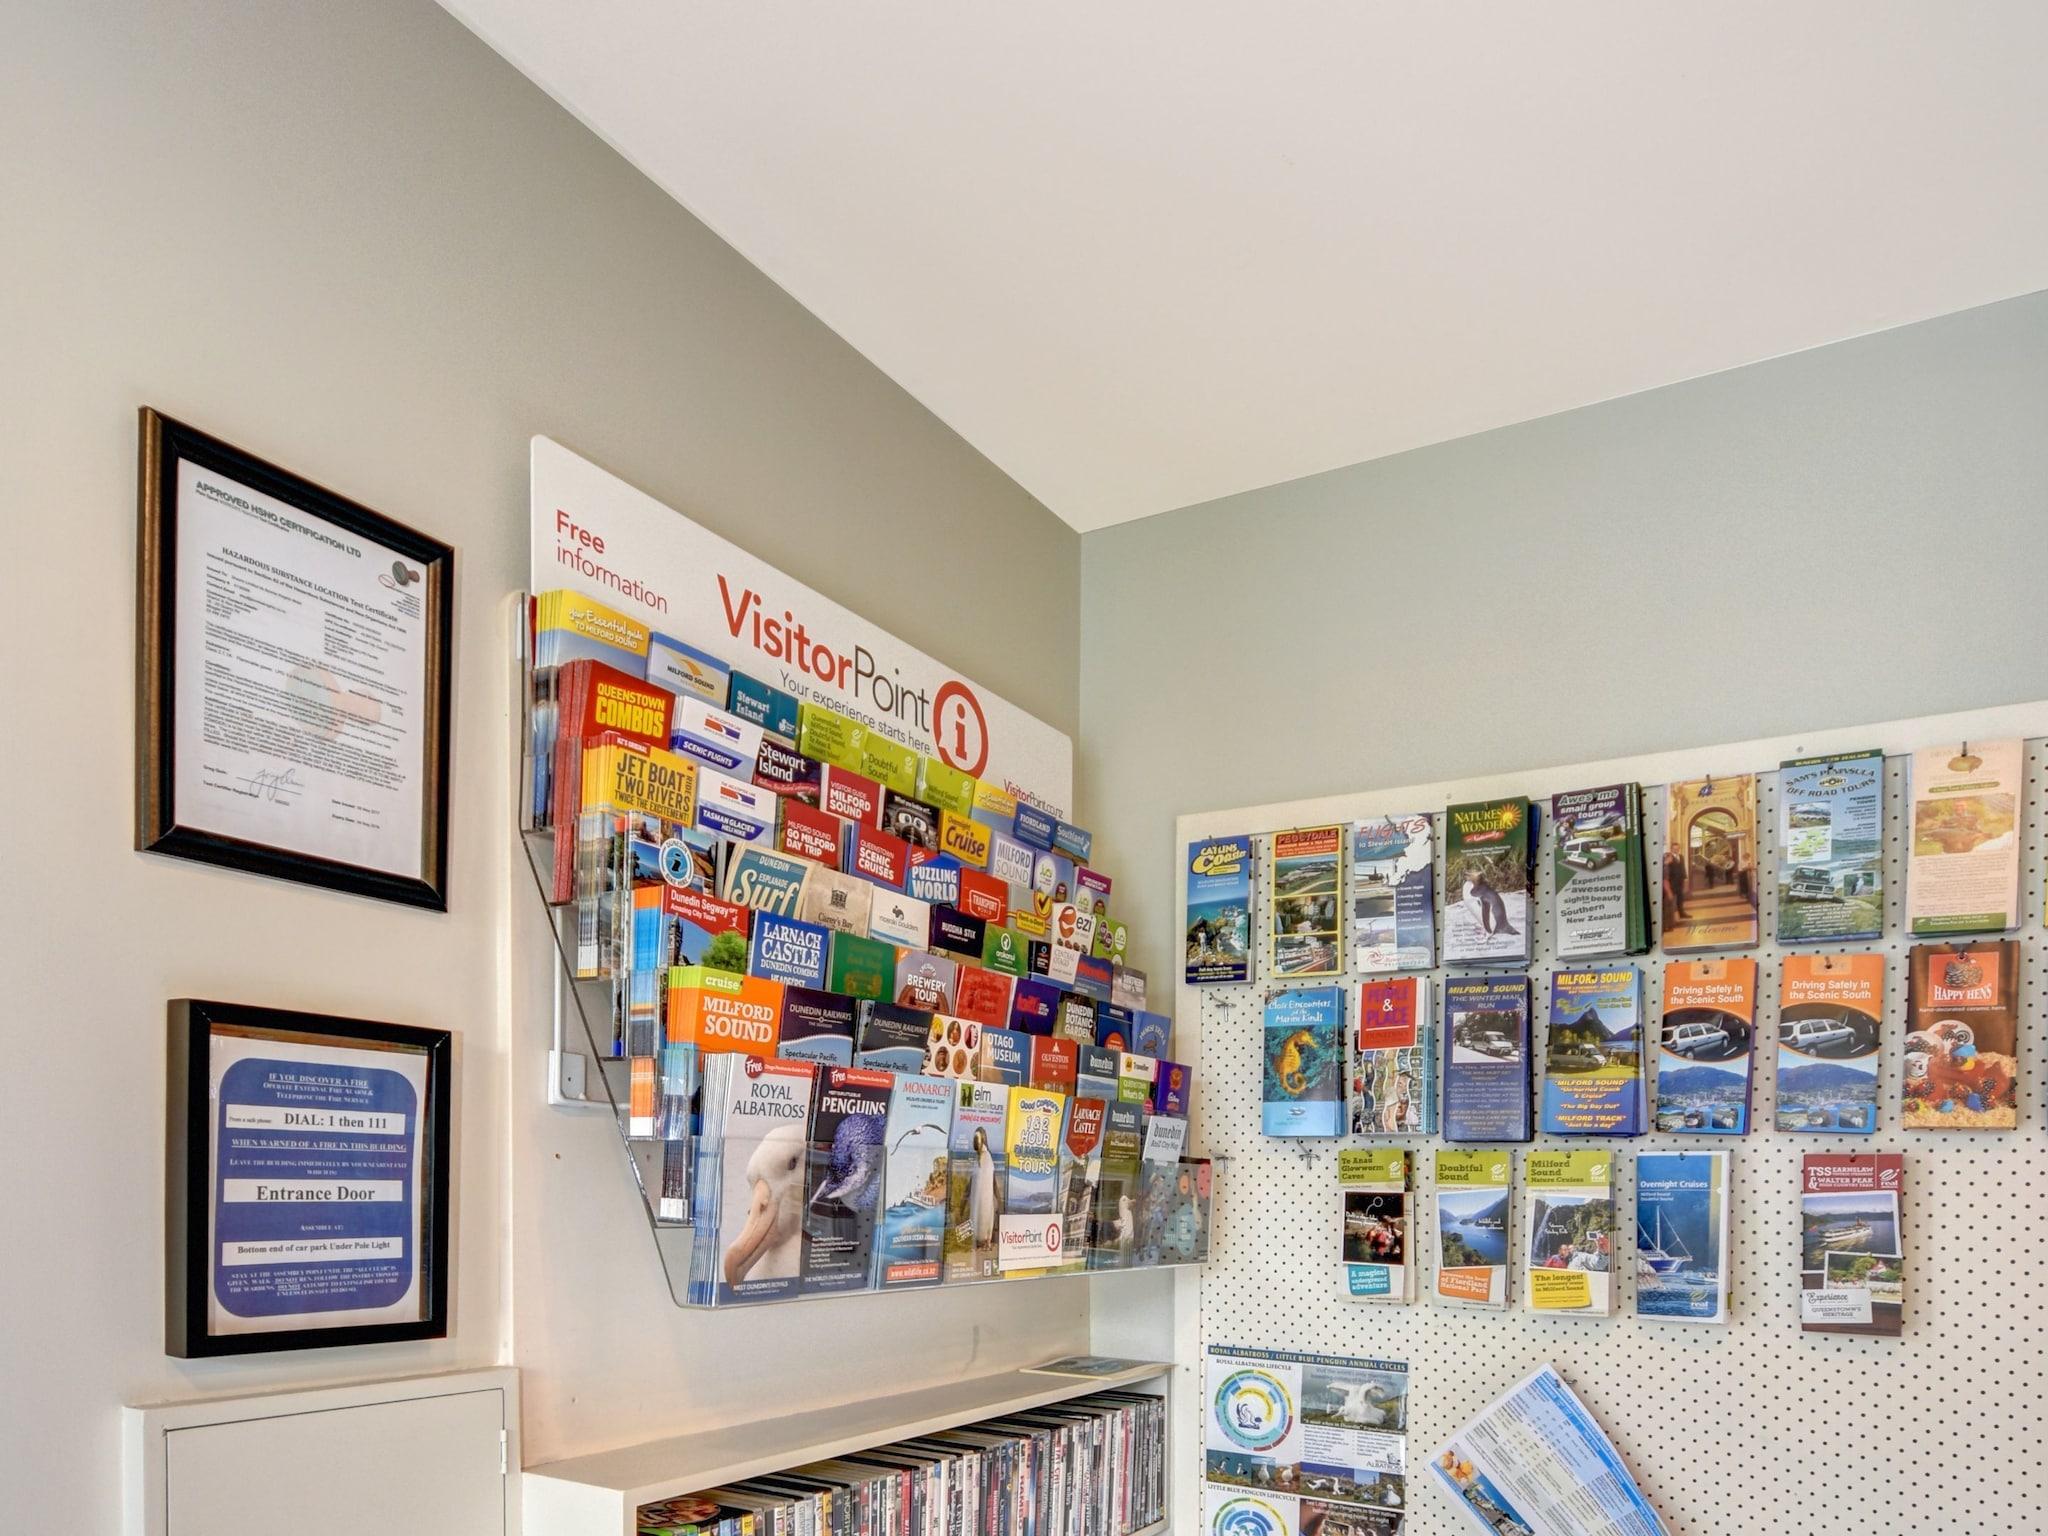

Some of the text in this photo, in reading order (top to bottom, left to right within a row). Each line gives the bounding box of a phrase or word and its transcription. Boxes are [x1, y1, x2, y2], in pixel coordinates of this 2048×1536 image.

[196, 480, 362, 558] APPROVED HSNO CERTIFICATION LTD
[556, 509, 605, 554] Free
[222, 546, 398, 622] HAZARDOUS SUBSTANCE LOCATION Test Certificate
[557, 539, 668, 614] information
[717, 573, 931, 733] VisitorPoint
[597, 683, 665, 710] QUEENSTOWN
[736, 690, 770, 713] Stewart
[595, 697, 665, 738] COMBOS
[736, 703, 764, 722] Island
[780, 669, 933, 756] Your experience starts here.
[683, 741, 733, 767] SCENIC FLIGHTS
[759, 742, 806, 772] Stewart
[617, 753, 686, 790] JET BOAT
[758, 760, 793, 782] Island
[616, 772, 690, 812] TWO RIVERS
[1786, 786, 1806, 795] OFF
[1841, 779, 1876, 793] TOURS
[614, 789, 689, 822] TWICE THE EXCITEMENT!
[830, 789, 871, 812] MILFORD
[1003, 779, 1064, 819] VisitorPoint.co.nz
[1560, 800, 1616, 814] small group
[830, 801, 862, 818] SOUND
[1455, 809, 1502, 824] NATURES
[1578, 810, 1605, 819] tours
[703, 810, 756, 833] TASMAN GLACIER
[786, 838, 822, 857] DAY TRIP
[787, 828, 835, 852] GO MILFORD
[946, 826, 985, 858] Cruise
[859, 847, 891, 867] SCENIC
[1200, 843, 1238, 856] CATLINS
[759, 855, 791, 872] DUNEDIN
[858, 857, 894, 880] CRUISES
[912, 865, 957, 884] PUZZLING
[994, 861, 1029, 885] SOUND
[1572, 873, 1622, 885] Experience
[731, 869, 800, 918] Surf
[912, 880, 957, 902] WORLD
[1571, 885, 1623, 893] awesome
[671, 889, 729, 918] Dunedin Segway
[1561, 903, 1605, 917] Southern
[1076, 916, 1093, 934] ezi
[1566, 912, 1622, 924] New Zealand
[763, 922, 822, 950] LARNACH
[761, 938, 820, 969] CASTLE
[761, 959, 819, 978] DUNEDIN COMBOS
[705, 975, 740, 991] cruise
[907, 974, 946, 993] BREWERY
[1448, 984, 1525, 994] MILFORD SOUND
[1673, 984, 1743, 996] Driving Safely in
[1792, 980, 1870, 991] Driving Safely in
[1934, 983, 1993, 1000] HAPPY HENS
[914, 988, 937, 1003] TOUR
[1670, 994, 1744, 1005] the Scenic South
[1789, 990, 1871, 1000] the Scenic South
[703, 996, 774, 1022] MILFORD
[789, 1003, 852, 1020] DUNEDIN RAILWAYS
[1066, 1002, 1094, 1018] DUNEDIN
[1382, 998, 1393, 1012] &
[704, 1015, 773, 1043] SOUND
[874, 1018, 929, 1034] DUNEDIN RAILWAYS
[1065, 1013, 1094, 1028] BOTANIC
[988, 1032, 1014, 1049] OTAGO
[1064, 1025, 1090, 1039] GARDEN
[784, 1048, 837, 1062] Spectacular Pacific
[987, 1047, 1021, 1064] MUSEUM
[745, 1059, 763, 1073] Free
[831, 1070, 846, 1083] Free
[751, 1083, 793, 1100] ROYAL
[903, 1082, 951, 1096] MONARCH
[732, 1100, 805, 1118] ALBATROSS
[821, 1096, 886, 1116] PENGUINS
[1073, 1103, 1101, 1119] LARNACH
[284, 1113, 324, 1125] DIAL:
[329, 1114, 334, 1126] 1
[339, 1115, 364, 1128] then
[369, 1117, 387, 1128] 111
[1073, 1119, 1096, 1134] CASTLE
[1021, 1129, 1050, 1146] HOUR
[1019, 1159, 1051, 1174] TOURS
[1342, 1164, 1384, 1172] Glowworm
[1439, 1164, 1484, 1172] Doubtful
[1531, 1159, 1570, 1168] Milford
[1531, 1168, 1562, 1176] Sound
[1808, 1166, 1832, 1176] TSS
[1438, 1173, 1469, 1181] Sound
[1640, 1181, 1708, 1189] Overnight Cruises
[256, 1186, 375, 1200] Entrance Door
[1001, 1229, 1042, 1245] VisitorPoint
[238, 1246, 267, 1254] Bottom
[269, 1245, 283, 1253] end
[285, 1244, 294, 1252] of
[310, 1243, 327, 1252] park
[330, 1242, 352, 1250] Under
[371, 1241, 390, 1250] Light
[1552, 1273, 1584, 1282] longest
[1807, 1292, 1849, 1304] Experience
[1210, 1347, 1231, 1355] ROYAL
[1232, 1349, 1269, 1359] ALBATROSS
[1317, 1356, 1349, 1366] PENGUIN
[1350, 1359, 1377, 1369] ANNUAL
[1379, 1362, 1406, 1372] CYCLES
